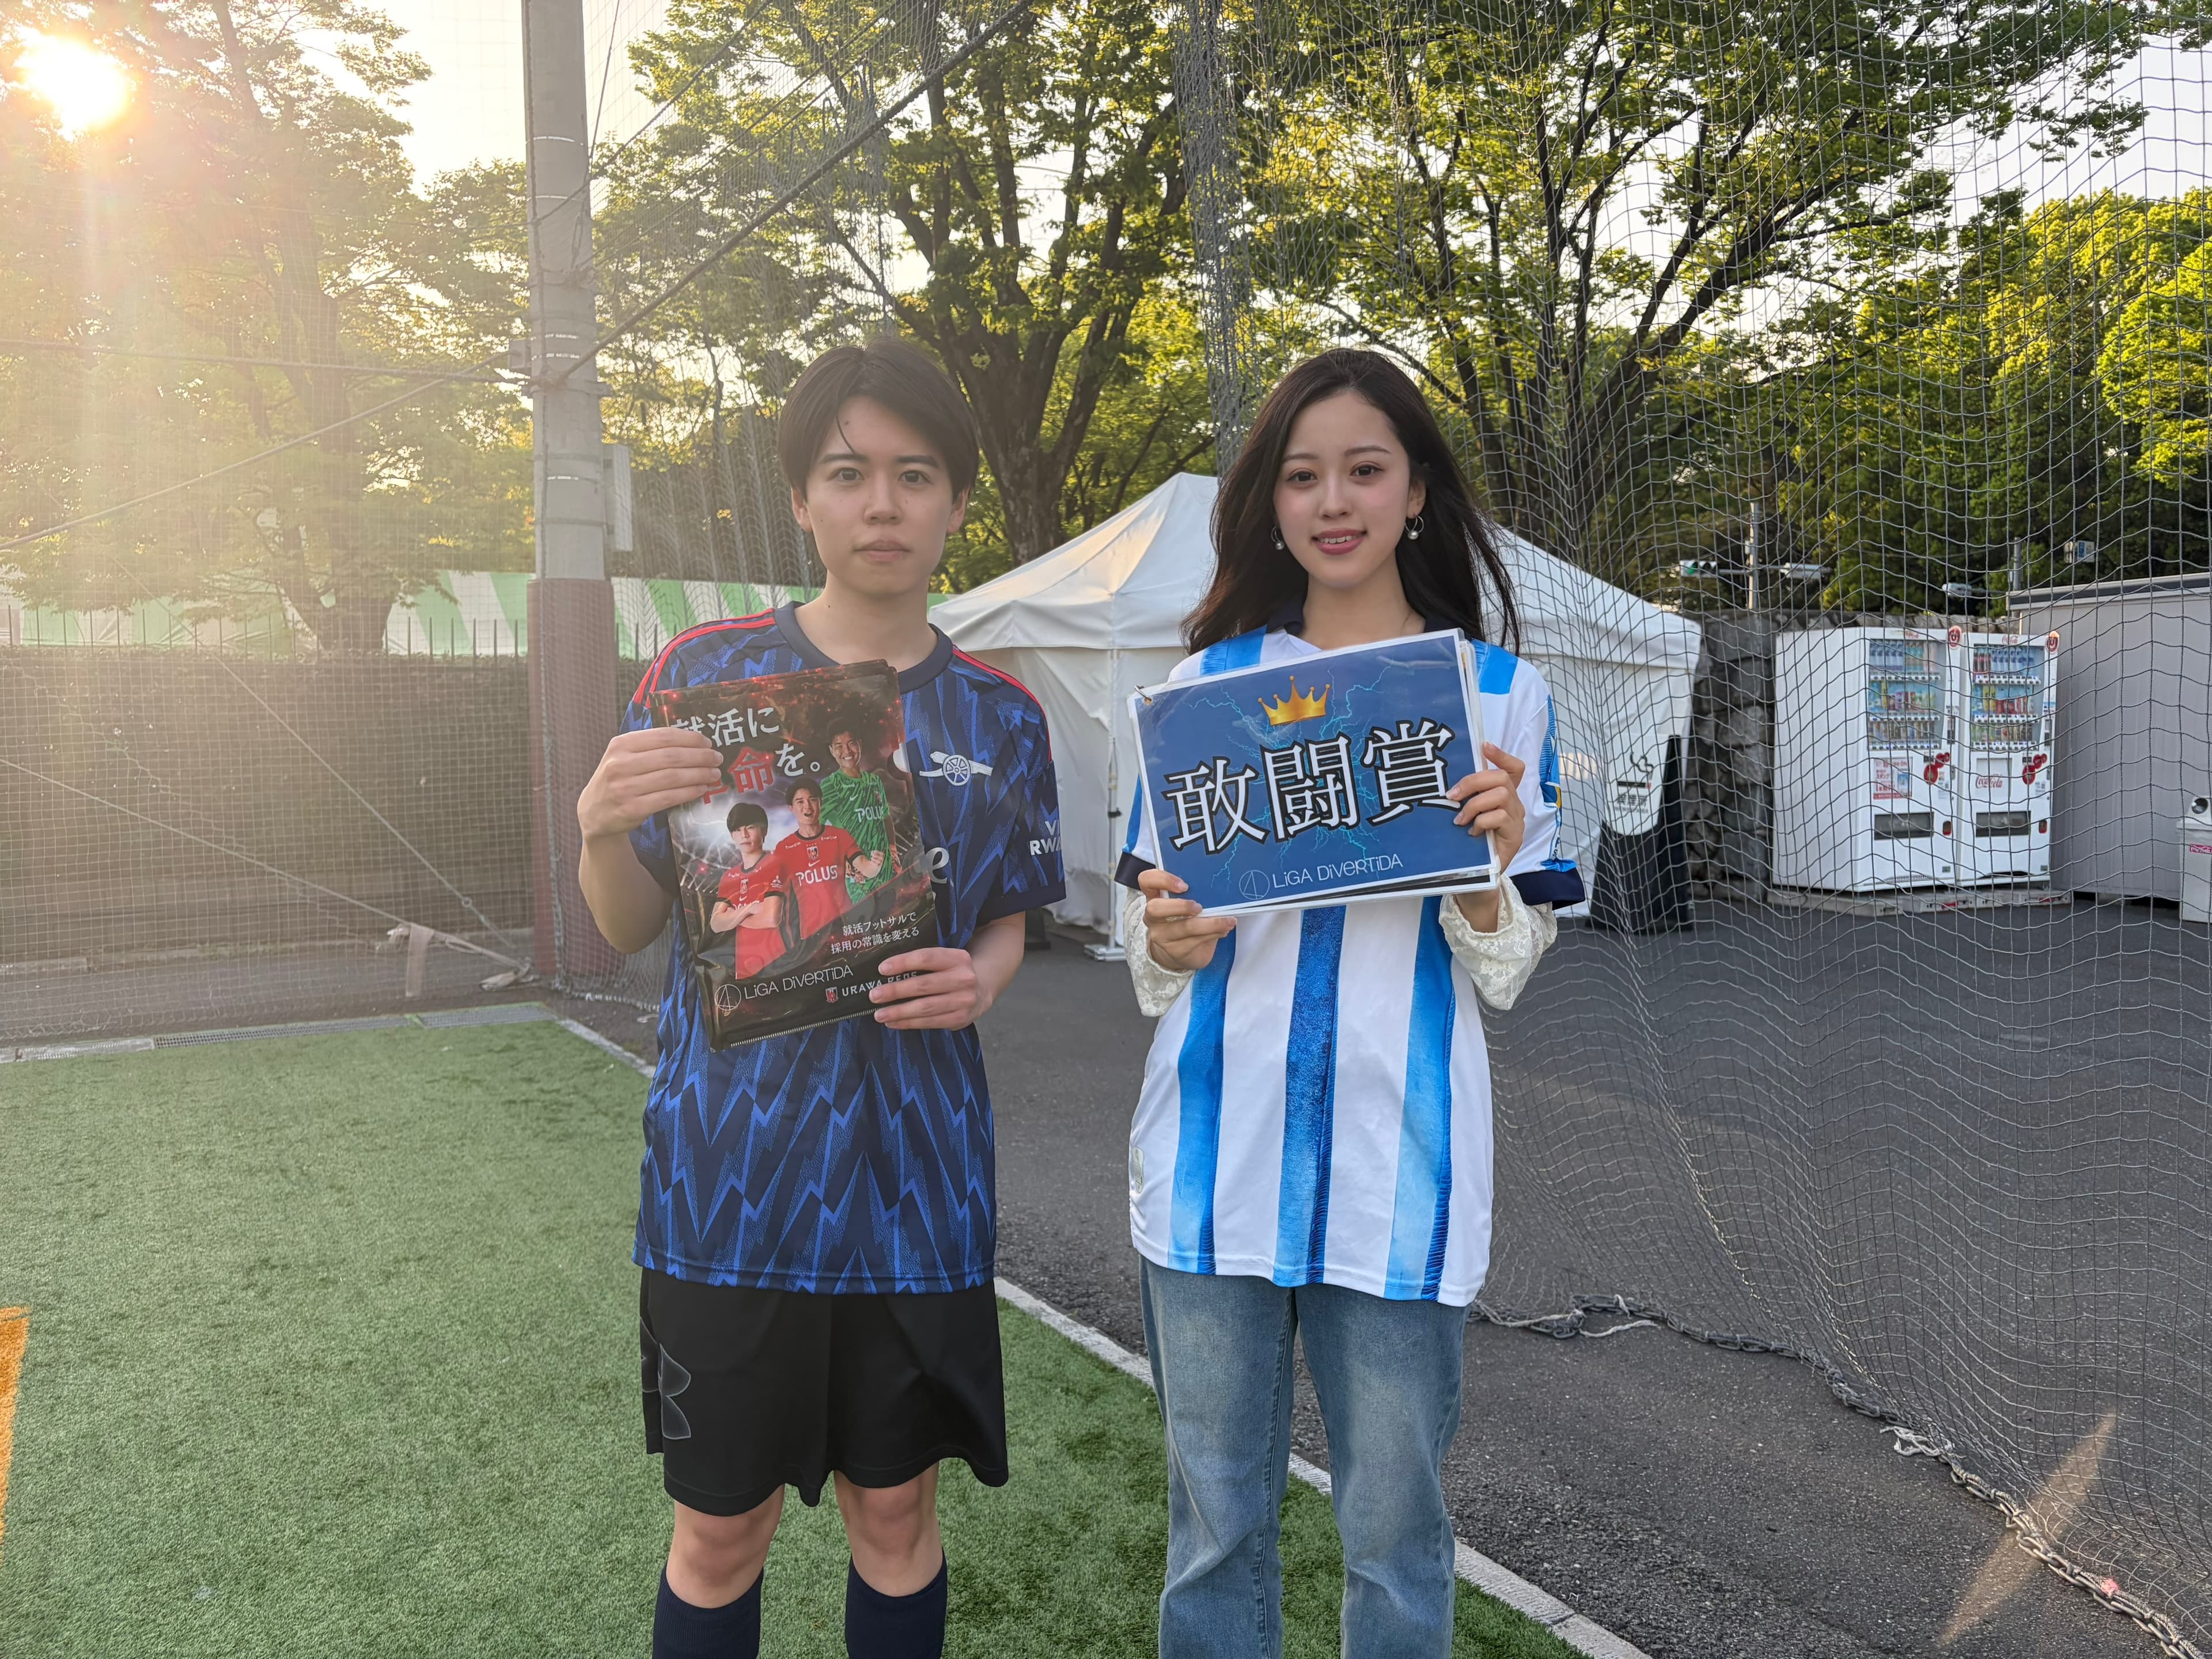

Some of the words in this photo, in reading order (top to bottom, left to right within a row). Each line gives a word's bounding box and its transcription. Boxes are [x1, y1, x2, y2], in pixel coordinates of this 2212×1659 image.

[702, 743, 820, 805] 命を。
[1161, 717, 1462, 855] 敢闘賞
[796, 865, 838, 887] POLUS
[843, 912, 917, 937] 就活フットサルで
[831, 926, 919, 955] 採用の常識を変える
[842, 979, 882, 997] URAWA
